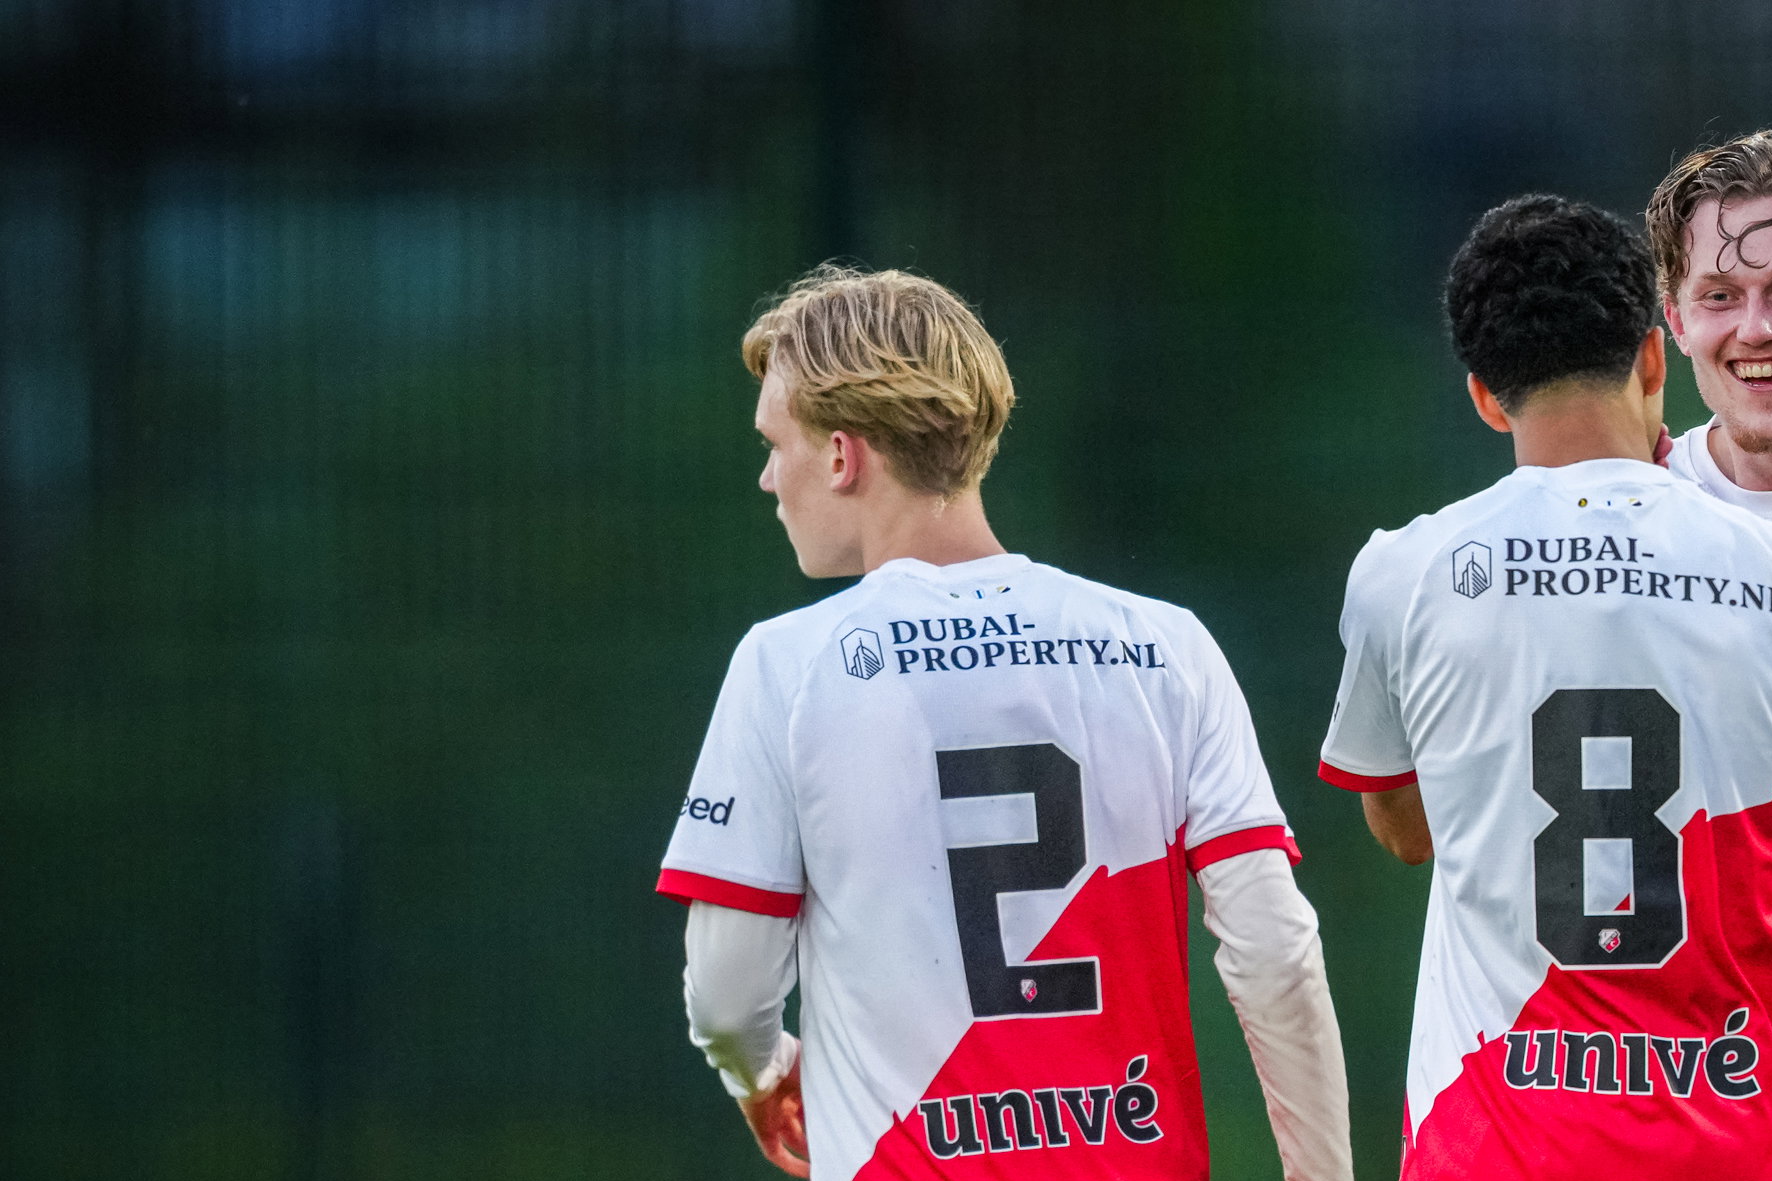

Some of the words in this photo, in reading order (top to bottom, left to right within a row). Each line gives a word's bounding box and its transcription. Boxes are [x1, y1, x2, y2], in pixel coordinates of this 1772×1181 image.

[1504, 535, 1655, 564] DUBAI-
[888, 613, 1036, 645] DUBAI-
[894, 638, 1167, 675] PROPERTY.NL
[1531, 688, 1688, 971] 8
[935, 740, 1103, 1022] 2
[1503, 1006, 1762, 1100] univé
[917, 1054, 1164, 1160] univé
